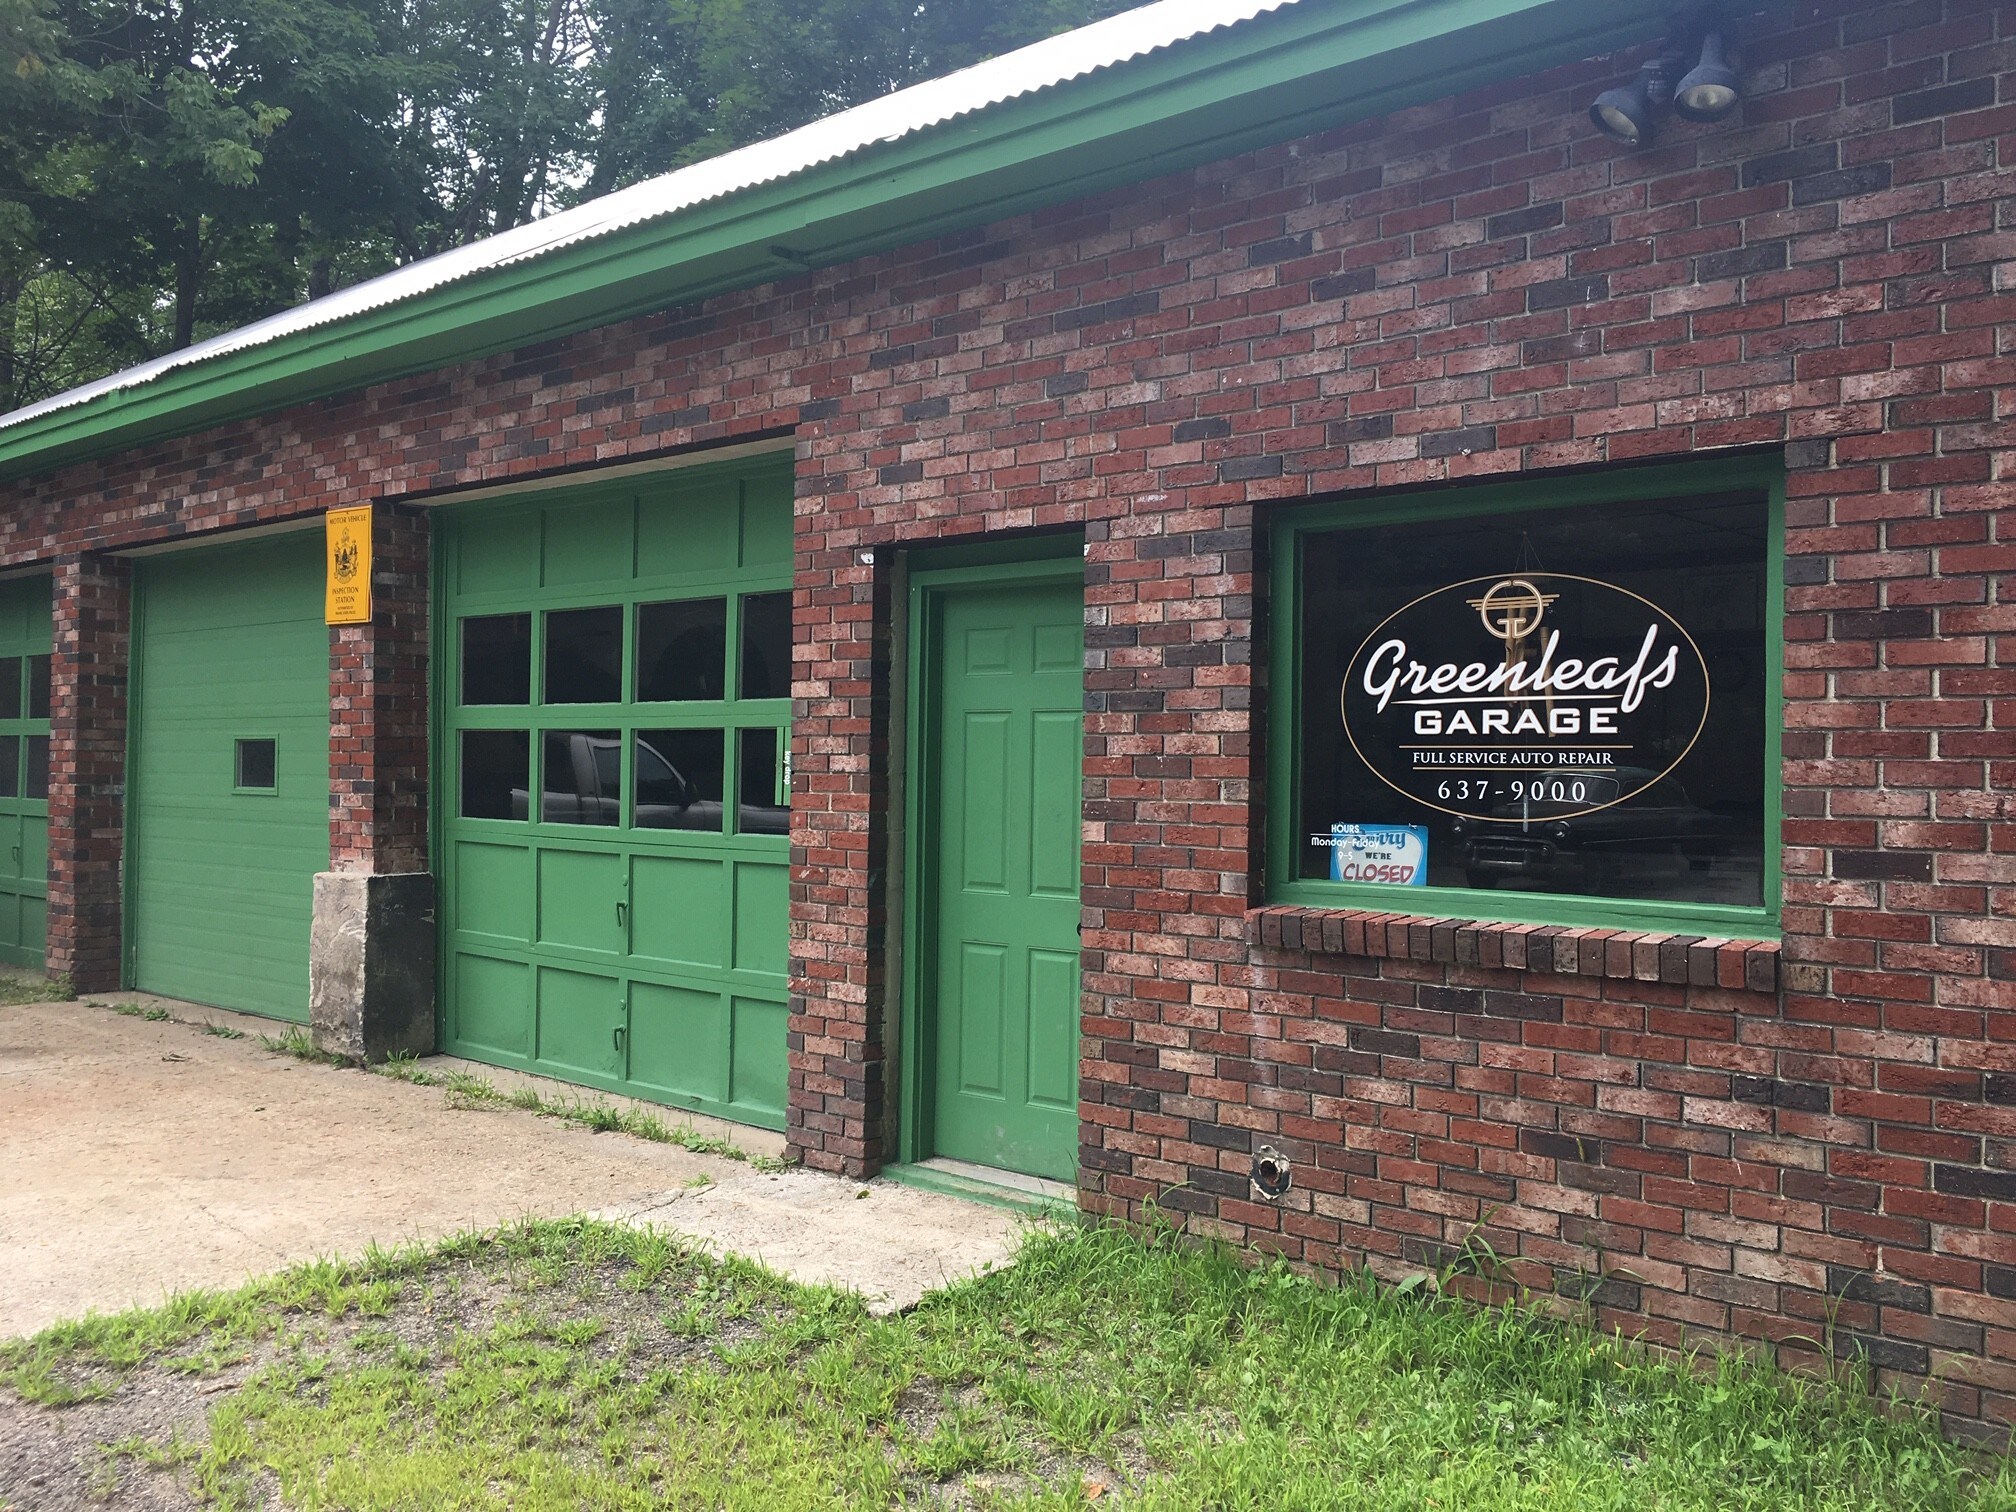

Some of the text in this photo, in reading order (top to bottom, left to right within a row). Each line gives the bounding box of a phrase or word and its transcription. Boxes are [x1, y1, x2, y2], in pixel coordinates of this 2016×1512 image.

[330, 514, 367, 525] MOTOR VEHICLE
[332, 585, 359, 595] INSPECTION
[335, 595, 355, 604] STATION
[1363, 623, 1679, 714] Greenleafs
[1414, 707, 1618, 735] GARAGE
[1413, 752, 1614, 765] FULL SERVICE AUTO REPAIR
[783, 766, 791, 785] drop
[1437, 780, 1586, 801] 637-9000
[1331, 824, 1360, 834] HOURS
[1338, 851, 1353, 860] 9-5
[1365, 851, 1392, 860] WE'RE
[1343, 863, 1414, 883] CLOSED
